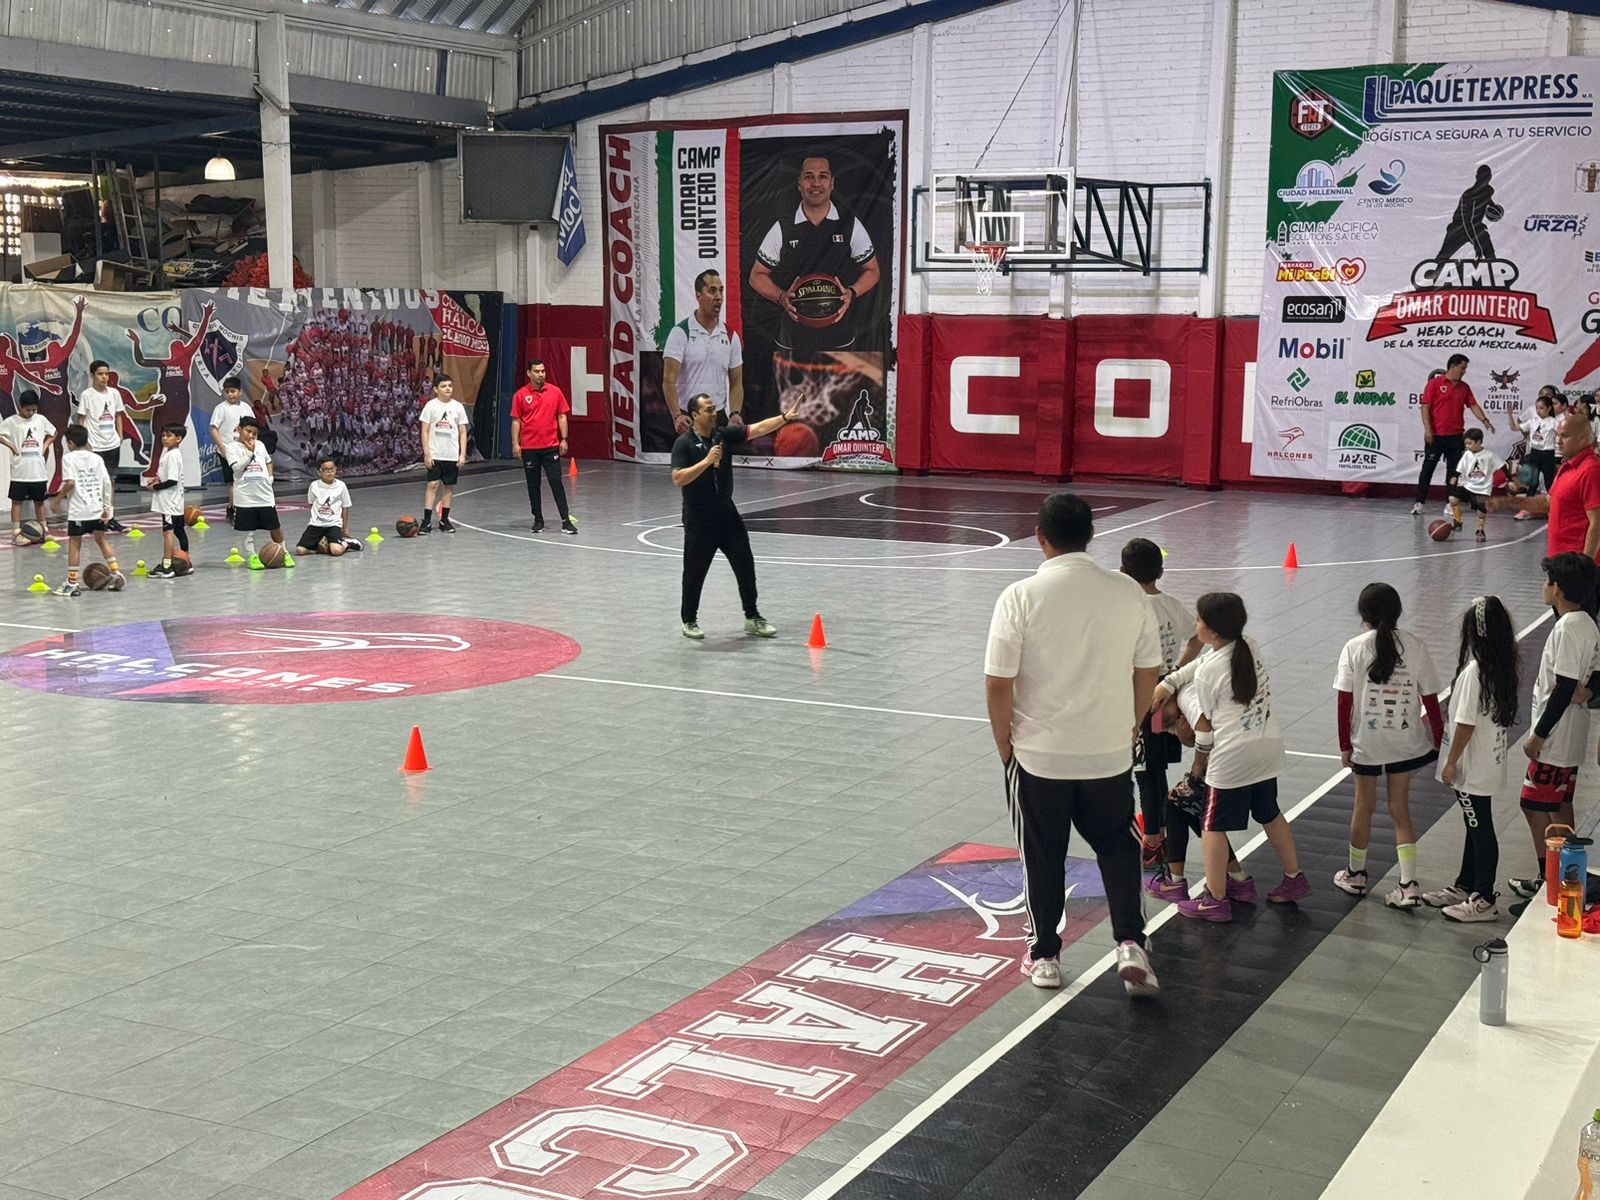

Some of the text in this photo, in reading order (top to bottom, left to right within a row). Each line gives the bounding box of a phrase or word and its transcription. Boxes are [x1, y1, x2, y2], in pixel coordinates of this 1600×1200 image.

[1389, 74, 1578, 105] PAQUETEXPRESS
[1364, 126, 1592, 142] LOGÍSTICA SEGURA A TU SERVICIO
[678, 146, 720, 170] CAMP
[1278, 187, 1354, 197] CIUDAD MILLENNIAL
[680, 173, 696, 231] OMAR
[697, 172, 718, 259] QUINTERO
[1328, 222, 1379, 232] PACIFICA
[1524, 219, 1578, 232] URZA
[1290, 233, 1333, 241] SOLUTIONS
[1413, 262, 1516, 288] CAMP
[608, 136, 636, 458] HEAD COACH
[797, 284, 836, 298] SPALDING
[1396, 294, 1530, 321] OMAR QUINTERO
[1417, 325, 1505, 338] HEAD COACH
[1279, 338, 1344, 359] Mobil
[1384, 337, 1538, 351] DE LA SELECCIÓN MEXICANA
[1271, 396, 1323, 408] RefriObras
[1335, 391, 1397, 406] EL NOPAL
[839, 429, 878, 441] CAMP
[833, 443, 885, 454] OMAR QUINTERO
[1267, 451, 1313, 459] HALCONES
[25, 649, 415, 693] HALCONES
[396, 931, 1016, 1200] HALC
